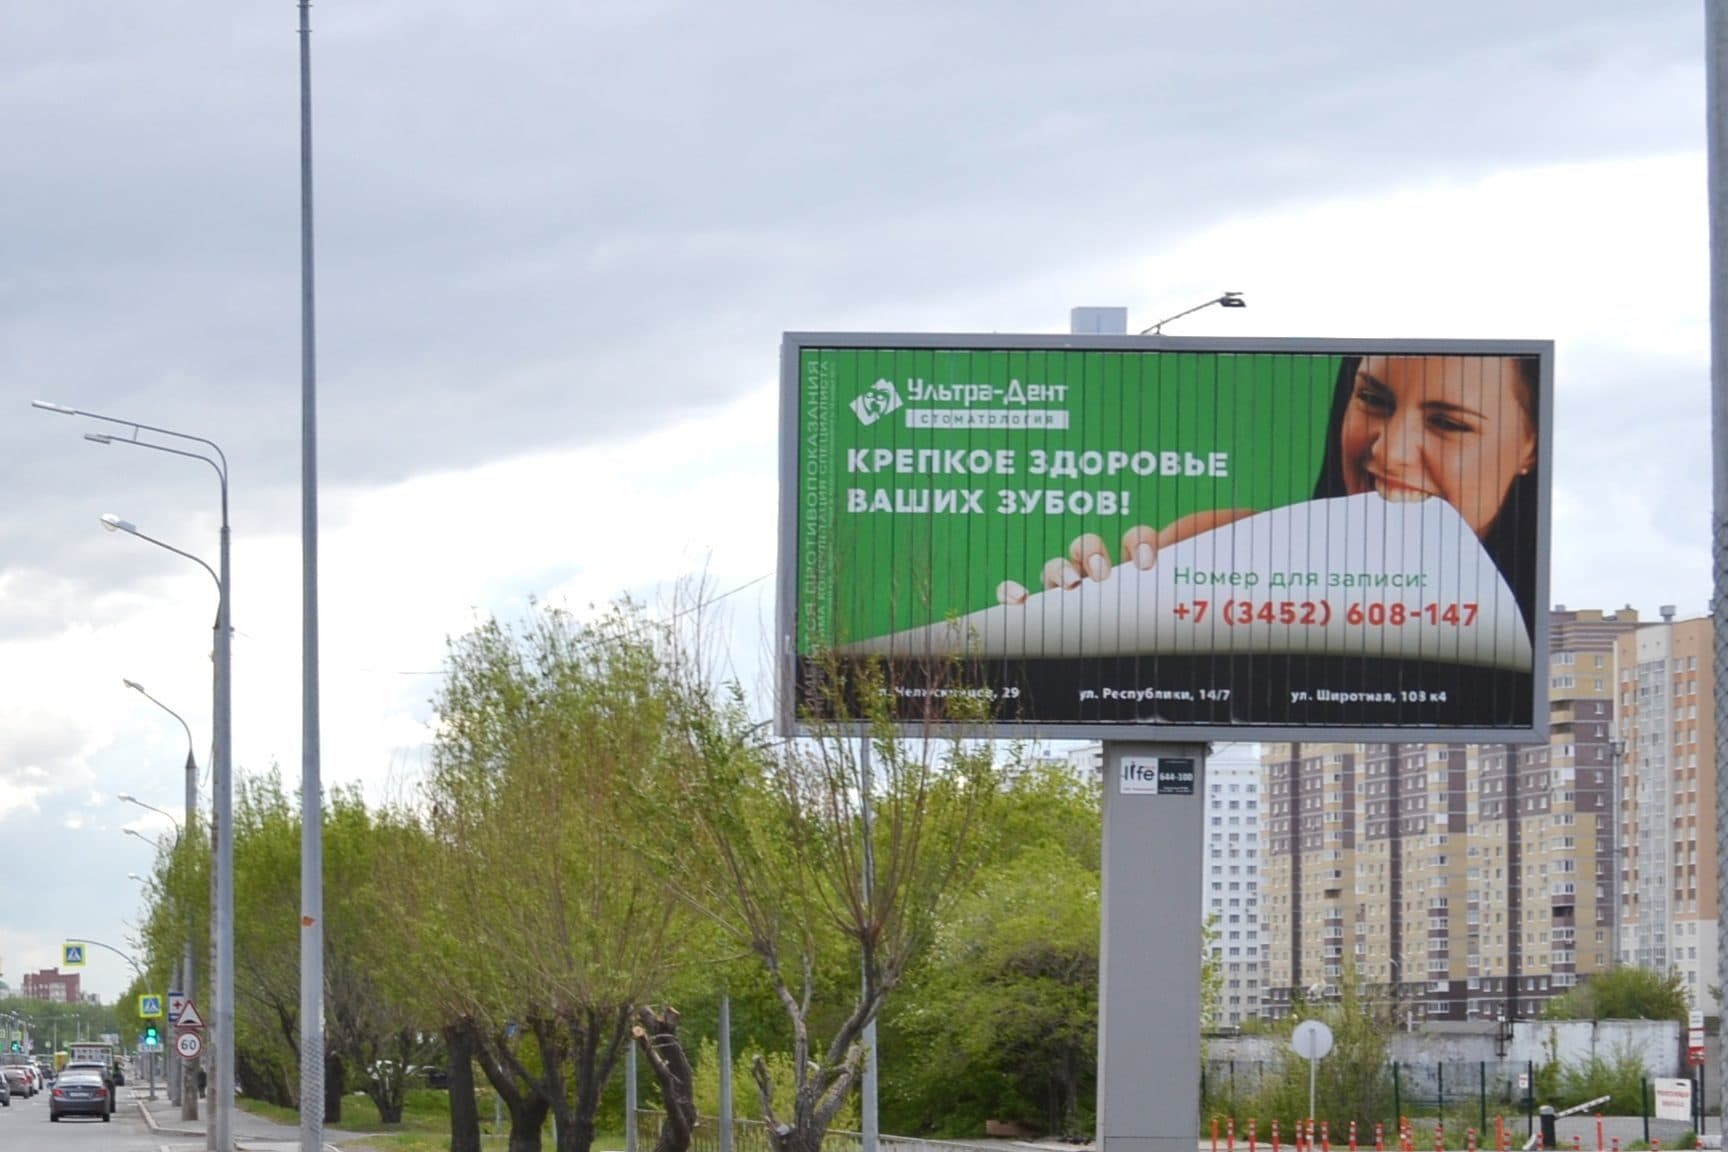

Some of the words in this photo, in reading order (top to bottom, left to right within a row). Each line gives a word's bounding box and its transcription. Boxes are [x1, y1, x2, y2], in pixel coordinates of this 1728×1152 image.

[907, 378, 1069, 407] Ультра-Дент
[920, 412, 1055, 426] СТОМАТОЛОГИЯ
[847, 448, 1015, 475] КРЕПКОЕ
[1029, 449, 1229, 479] ЗДОРОВЬЕ
[804, 360, 819, 594] ПРОТИВОПОКАЗАНИЯ
[847, 487, 984, 515] ВАШИХ
[997, 488, 1130, 516] ЗУБОВ!
[1174, 567, 1259, 589] Номер
[1269, 571, 1319, 589] для
[1328, 571, 1427, 588] записи:
[1173, 600, 1208, 625] +7
[1223, 599, 1332, 627] (3452)
[1347, 601, 1479, 627] 608-147
[1002, 686, 1020, 699] 29
[1079, 688, 1099, 702] ул.
[1102, 686, 1194, 703] Республики,
[1199, 688, 1231, 701] 14/7
[1290, 690, 1313, 704] ул.
[1316, 688, 1397, 704] Широтная,
[181, 1039, 197, 1050] 60
